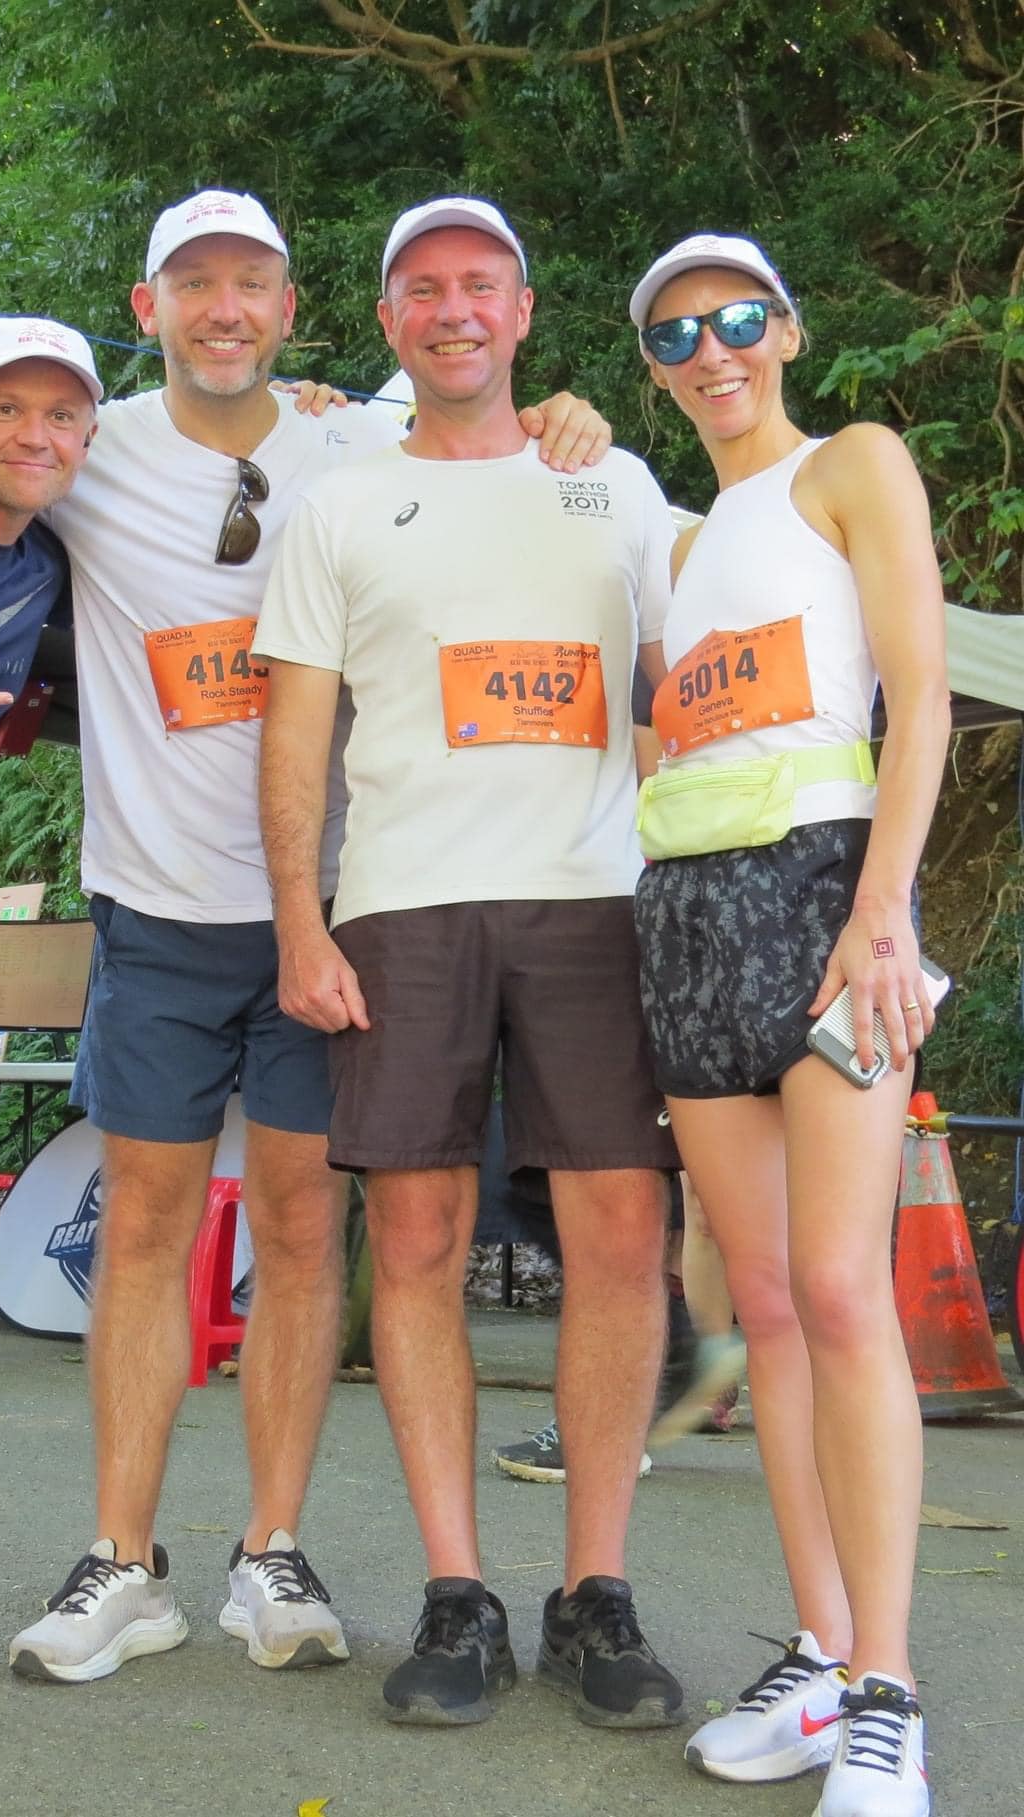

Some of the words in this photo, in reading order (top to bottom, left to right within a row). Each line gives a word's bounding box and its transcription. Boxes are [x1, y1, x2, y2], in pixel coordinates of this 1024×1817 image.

[556, 480, 609, 492] TOKYO
[559, 490, 610, 499] MARATHON
[560, 496, 611, 512] 2017
[156, 630, 193, 644] QUAD-M
[453, 645, 495, 657] QUAD-M
[678, 647, 760, 709] 5014
[200, 687, 226, 700] Rock
[228, 684, 264, 698] Steady
[484, 671, 575, 705] 4142
[512, 705, 555, 717] Shuffles
[697, 696, 735, 717] Geneva
